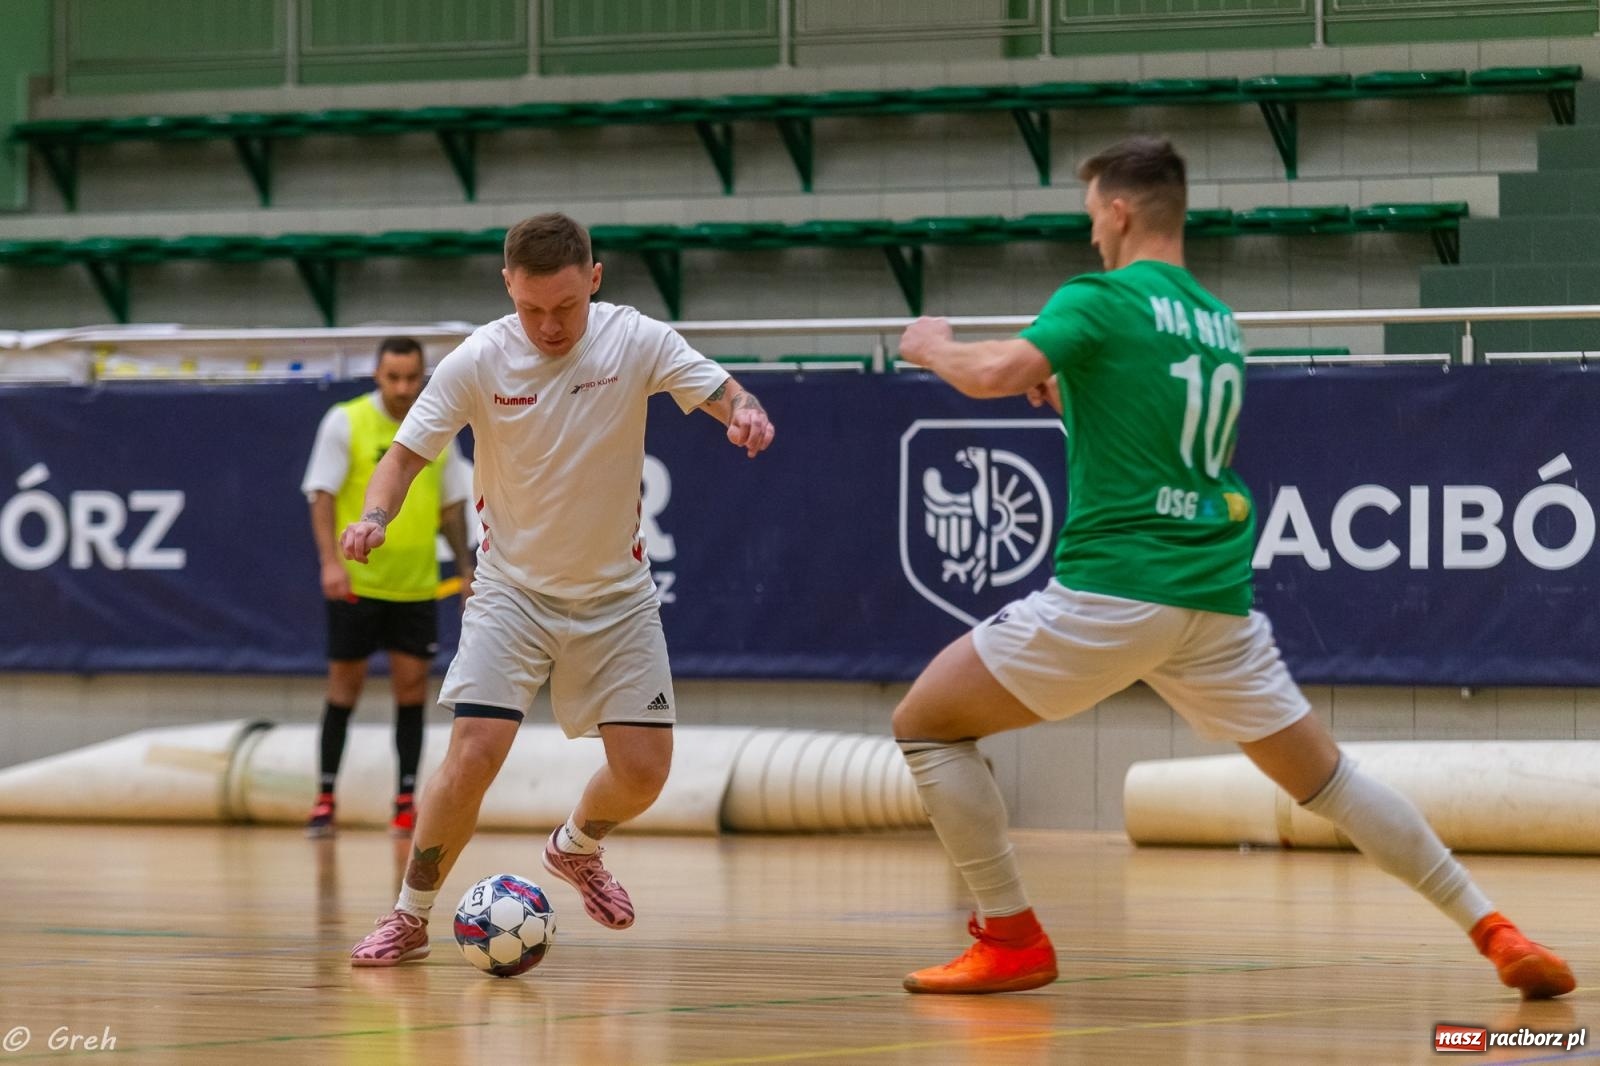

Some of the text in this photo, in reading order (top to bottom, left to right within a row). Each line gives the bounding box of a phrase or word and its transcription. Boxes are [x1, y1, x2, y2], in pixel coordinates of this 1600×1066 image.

[494, 393, 538, 406] hummel
[1169, 354, 1242, 480] 10
[0, 462, 187, 570] ÓRZ
